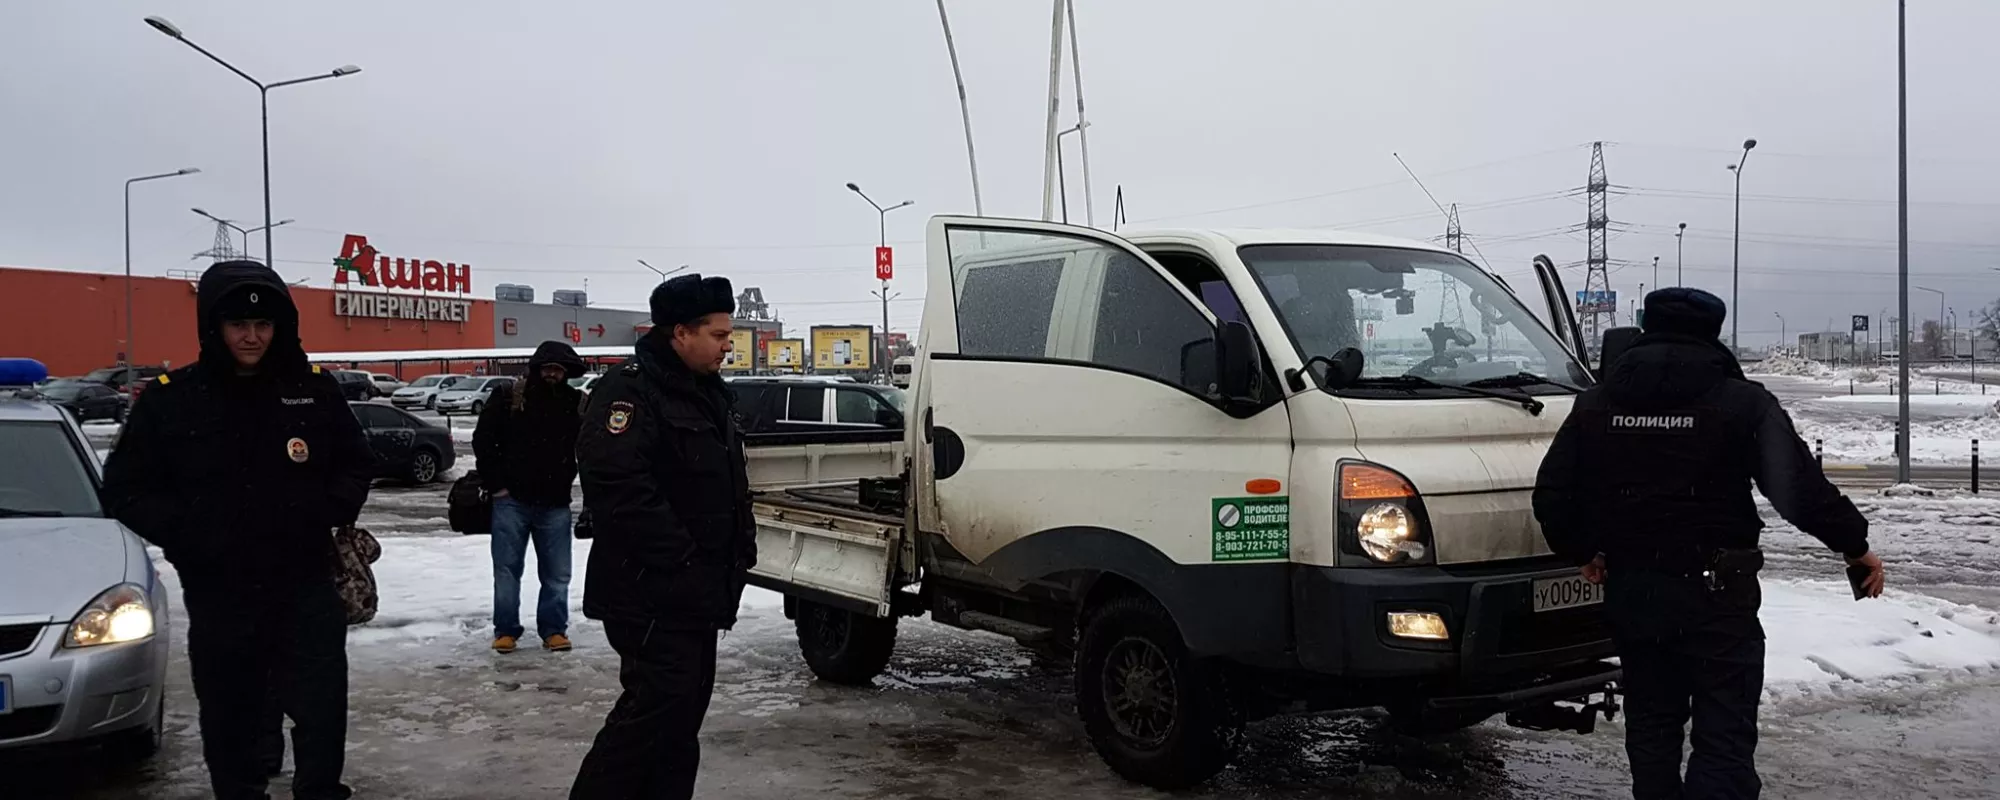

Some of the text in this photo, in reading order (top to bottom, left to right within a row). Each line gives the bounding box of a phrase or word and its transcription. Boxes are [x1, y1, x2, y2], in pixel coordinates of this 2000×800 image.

[335, 234, 471, 293] Ашан
[879, 264, 891, 274] 10
[335, 292, 472, 322] ГИПЕРМАРКЕТ
[1612, 415, 1694, 429] ПОЛИЦИЯ
